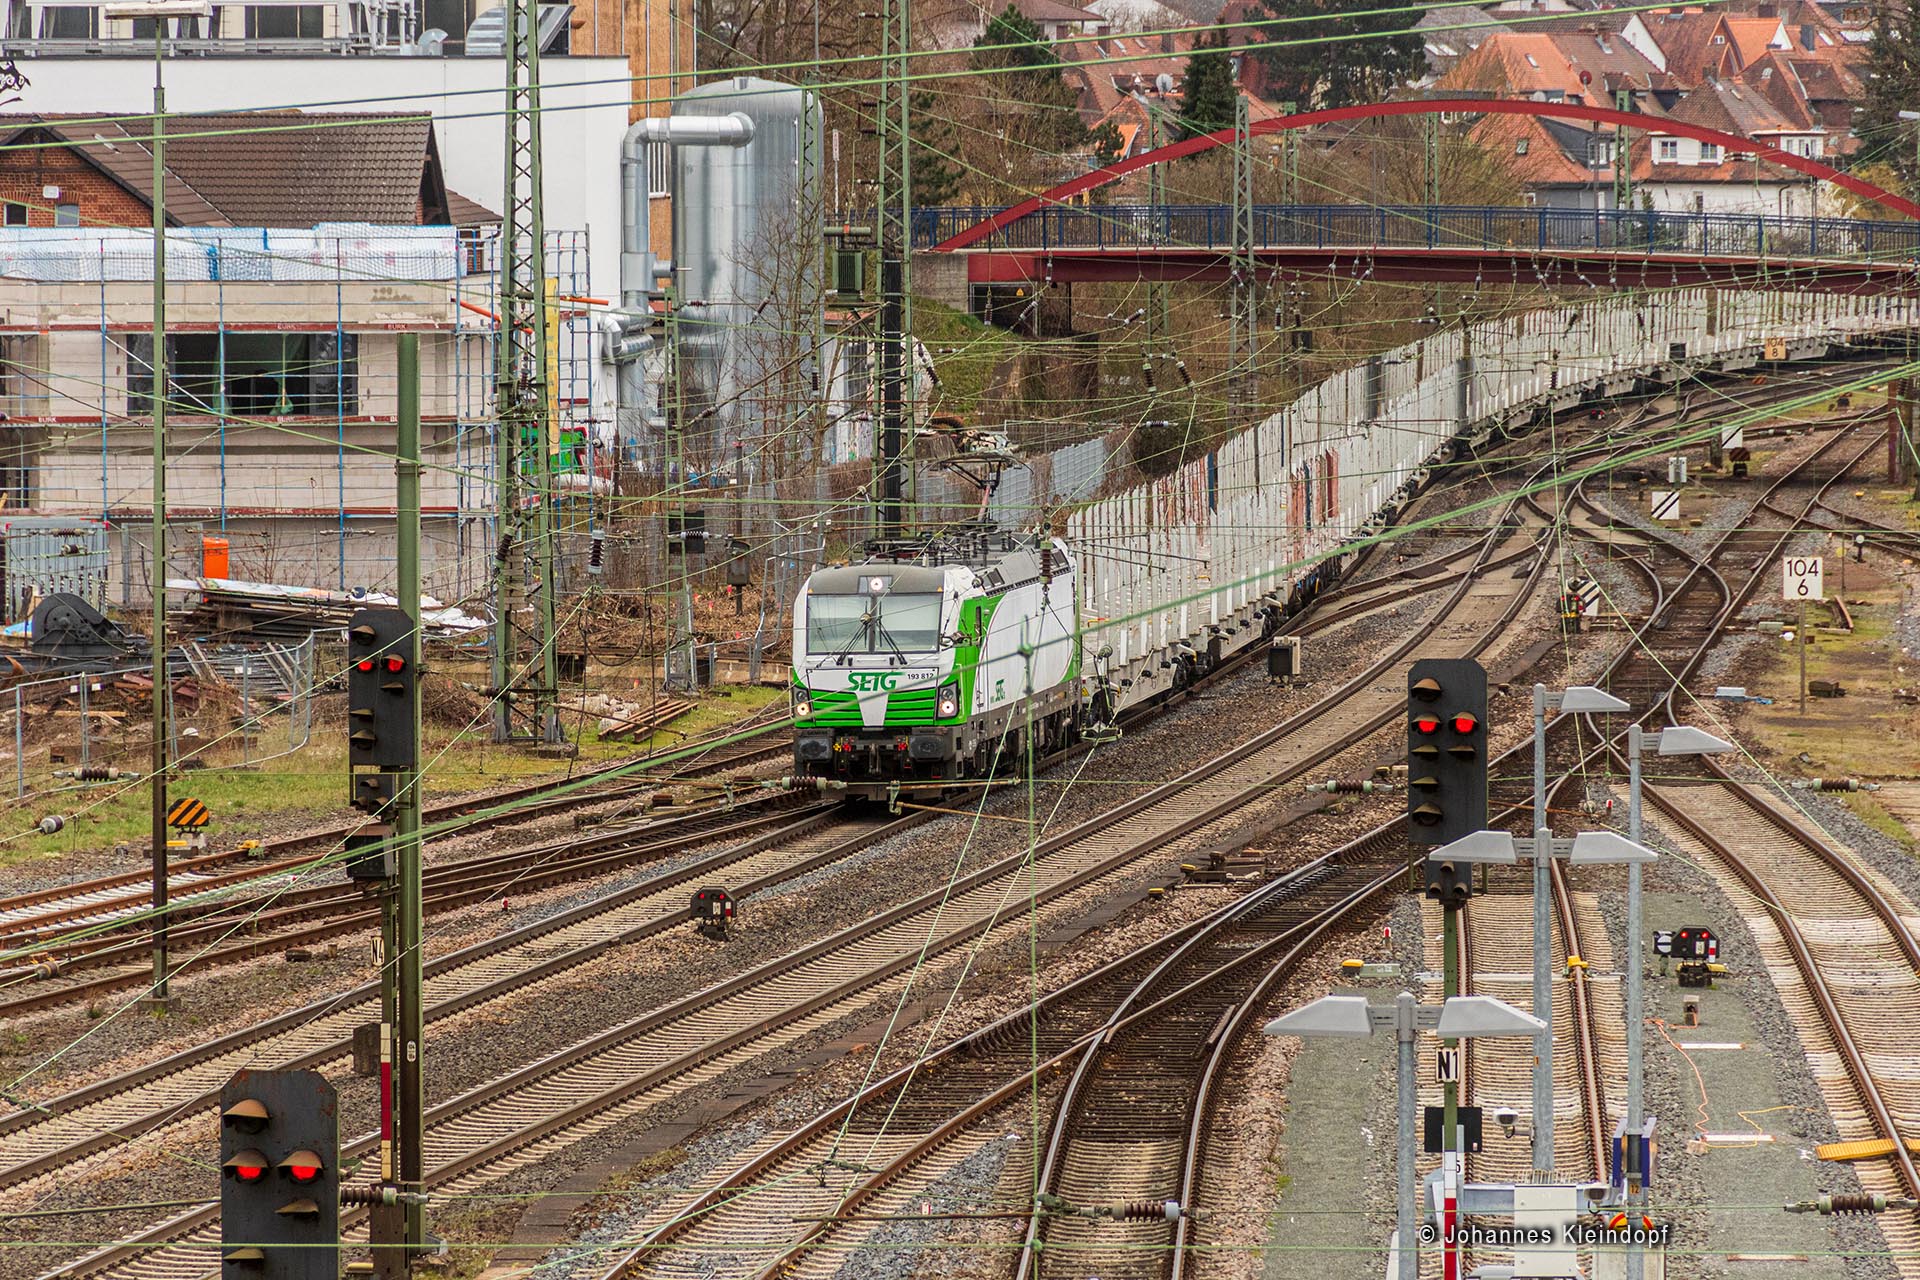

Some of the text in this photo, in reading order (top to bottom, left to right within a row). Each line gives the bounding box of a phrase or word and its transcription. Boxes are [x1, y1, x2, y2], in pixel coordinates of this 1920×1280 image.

[1767, 337, 1784, 346] 104
[1772, 348, 1777, 357] 8
[1787, 559, 1819, 576] 104
[1797, 579, 1808, 596] 6
[845, 672, 904, 692] SETG
[372, 939, 383, 963] N4
[1438, 1051, 1458, 1079] N1
[1631, 1184, 1640, 1194] 12
